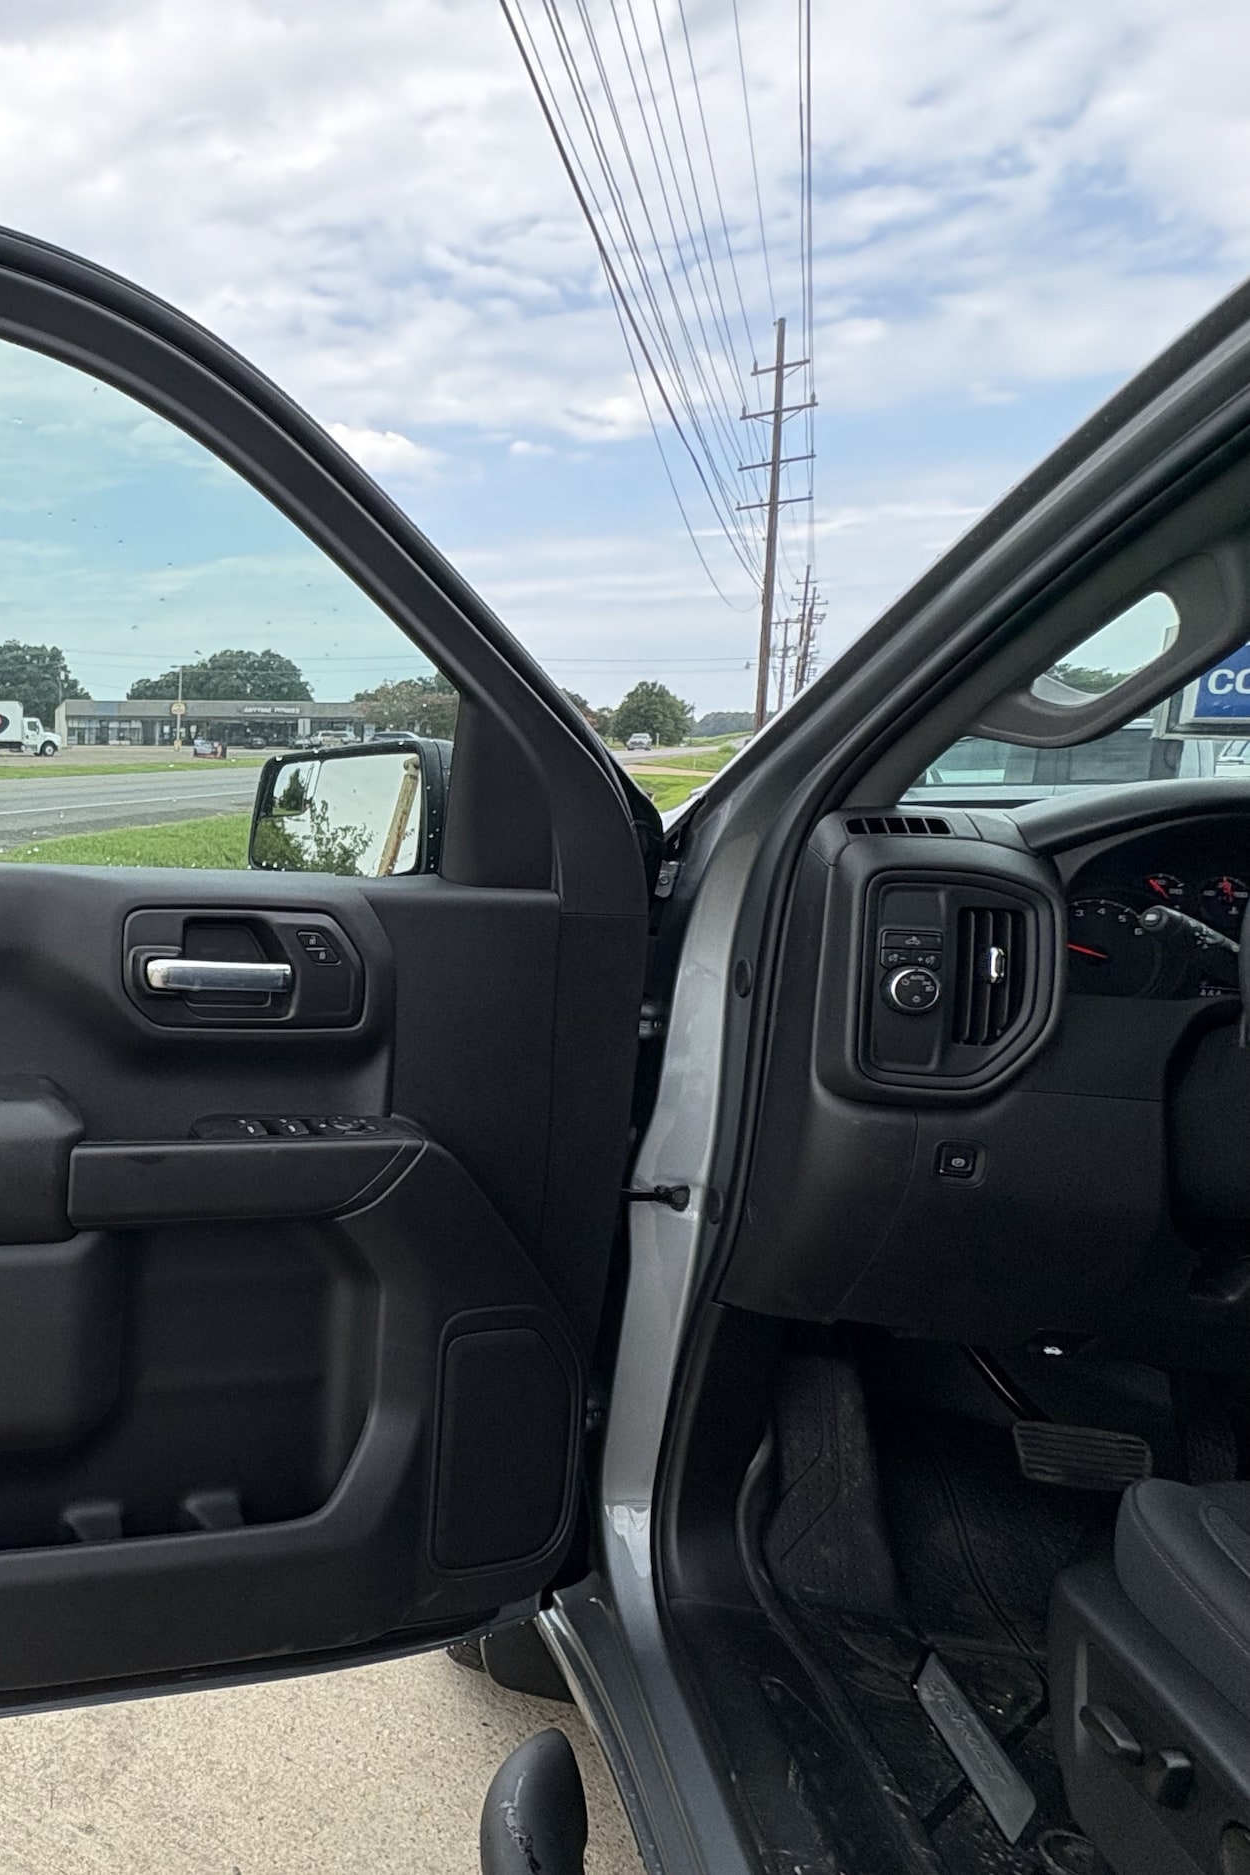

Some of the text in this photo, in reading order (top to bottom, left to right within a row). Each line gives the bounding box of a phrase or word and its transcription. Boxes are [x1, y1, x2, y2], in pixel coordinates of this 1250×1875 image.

[1075, 909, 1084, 918] 3
[1097, 908, 1107, 916] 4
[1118, 914, 1127, 923] 5
[1134, 927, 1144, 936] 6
